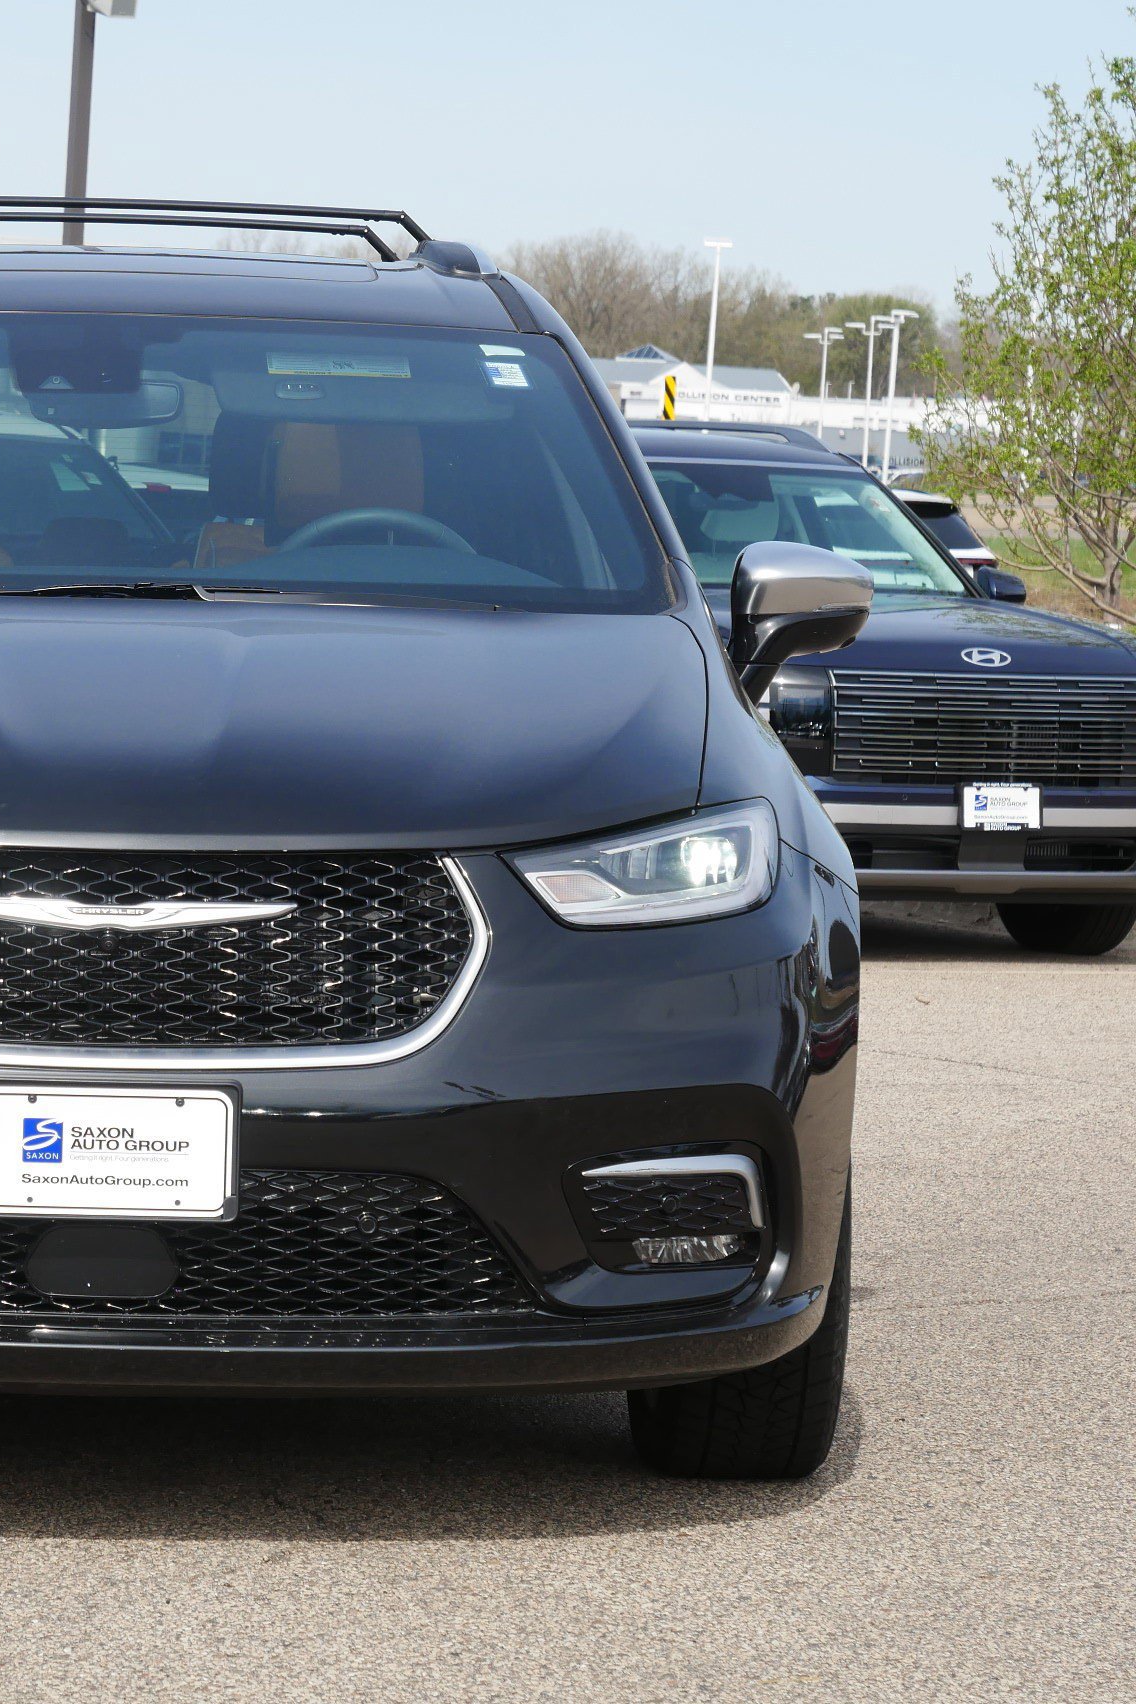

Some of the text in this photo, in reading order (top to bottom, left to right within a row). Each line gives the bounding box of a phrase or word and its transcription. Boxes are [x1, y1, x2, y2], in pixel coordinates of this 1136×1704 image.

[677, 391, 781, 404] OLLISON CENTER
[889, 456, 925, 467] OLLISION
[72, 907, 145, 915] CHRYSLER
[70, 1126, 135, 1139] SAXON
[70, 1139, 190, 1152] AUTO GROUP
[25, 1152, 59, 1160] SAXON
[21, 1173, 189, 1188] SaxonAutoGroup.com
